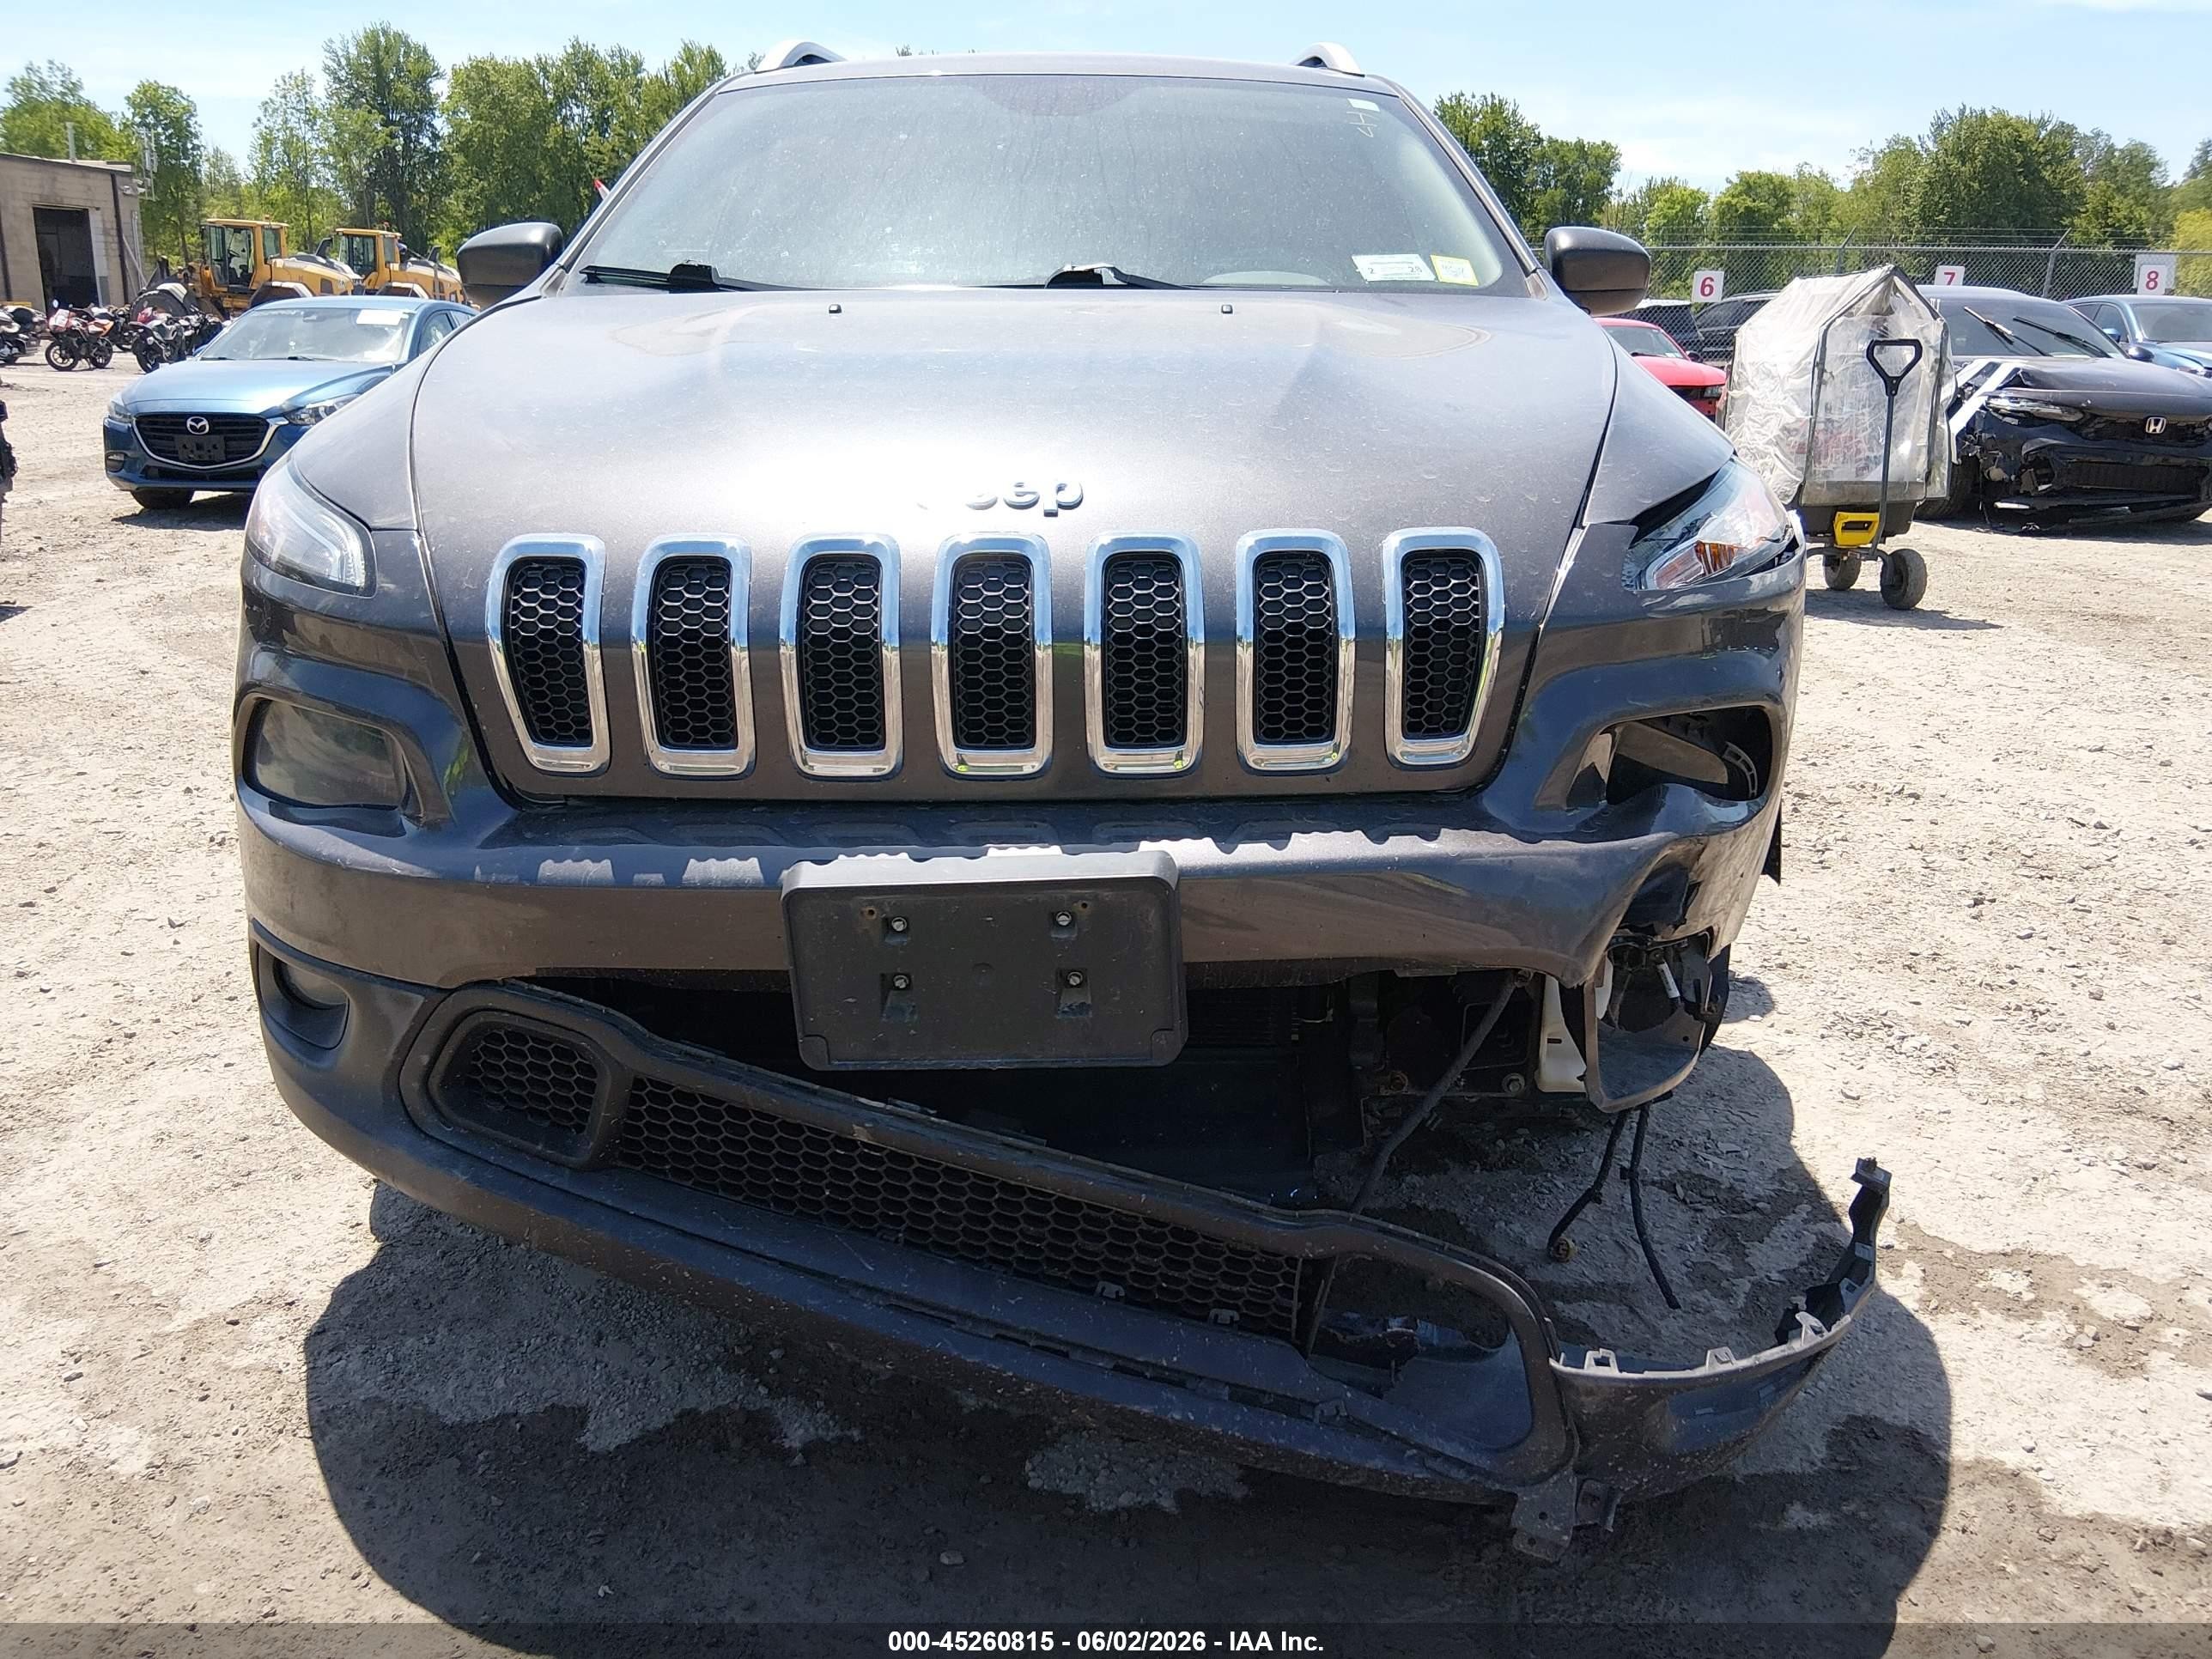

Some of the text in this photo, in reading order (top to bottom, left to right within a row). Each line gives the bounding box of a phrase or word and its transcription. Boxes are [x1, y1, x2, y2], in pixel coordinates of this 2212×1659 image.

[1699, 276, 1715, 297] 6
[1943, 271, 1956, 286] 7
[2145, 270, 2160, 291] 8
